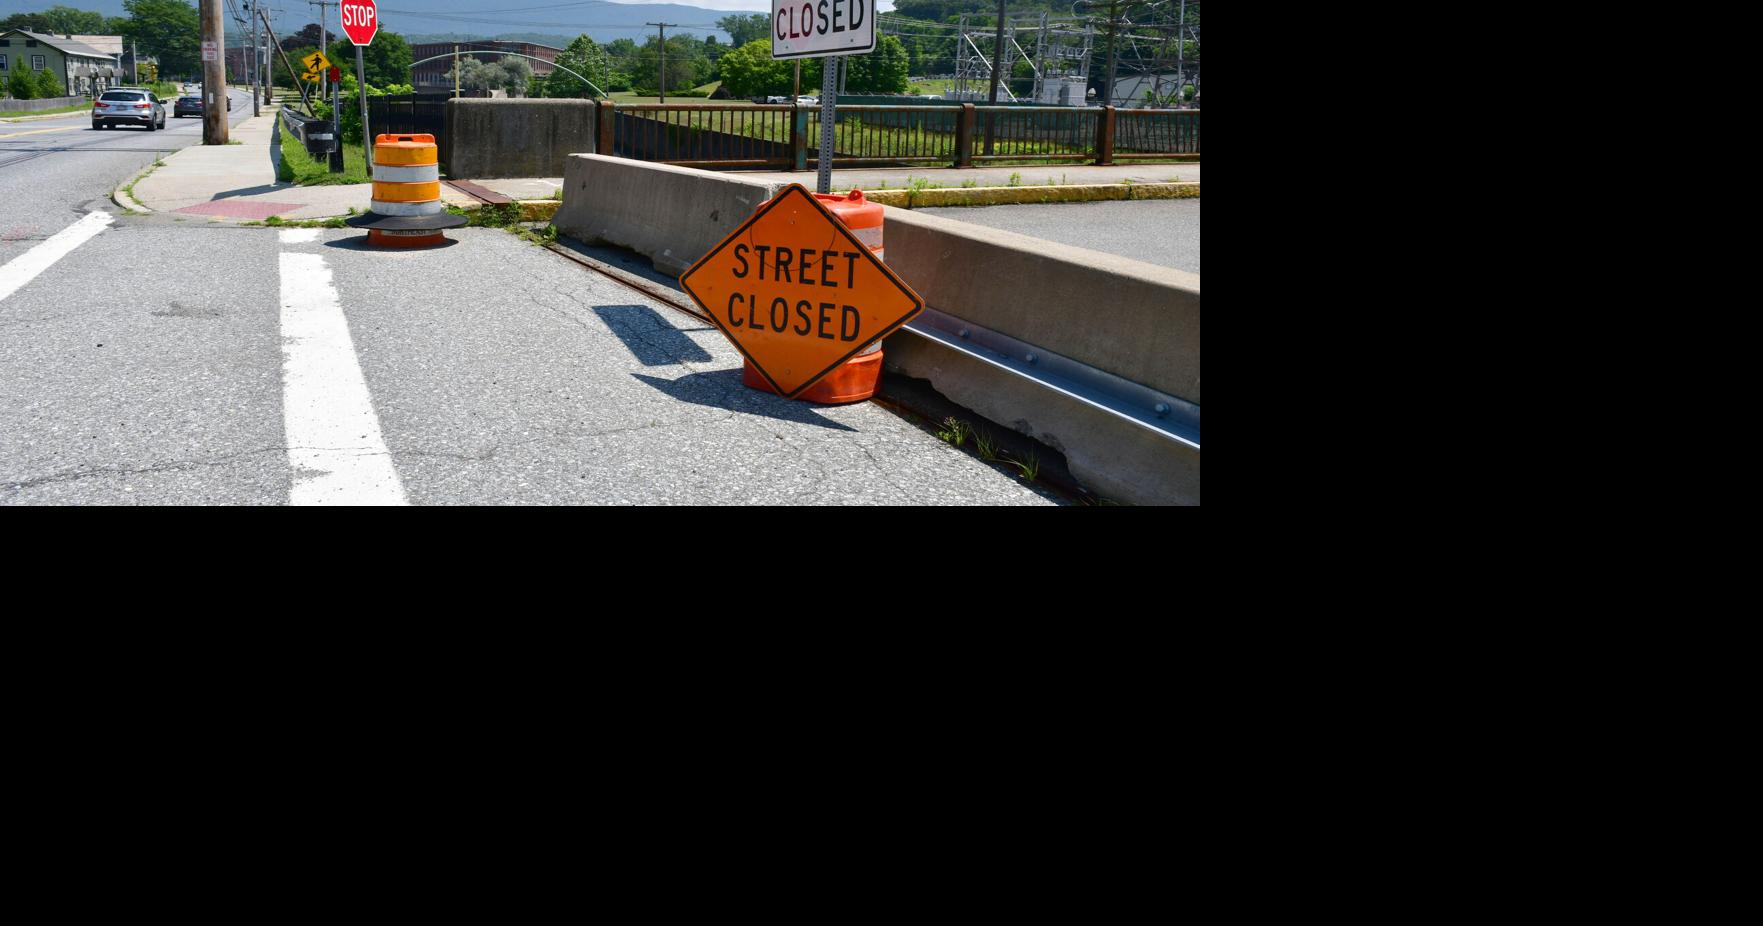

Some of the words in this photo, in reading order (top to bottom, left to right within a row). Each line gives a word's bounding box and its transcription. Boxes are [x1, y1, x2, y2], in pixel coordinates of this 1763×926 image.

[344, 4, 374, 27] STOP
[776, 0, 864, 41] CLOSED
[732, 243, 861, 289] STREET
[727, 292, 861, 342] CLOSED
